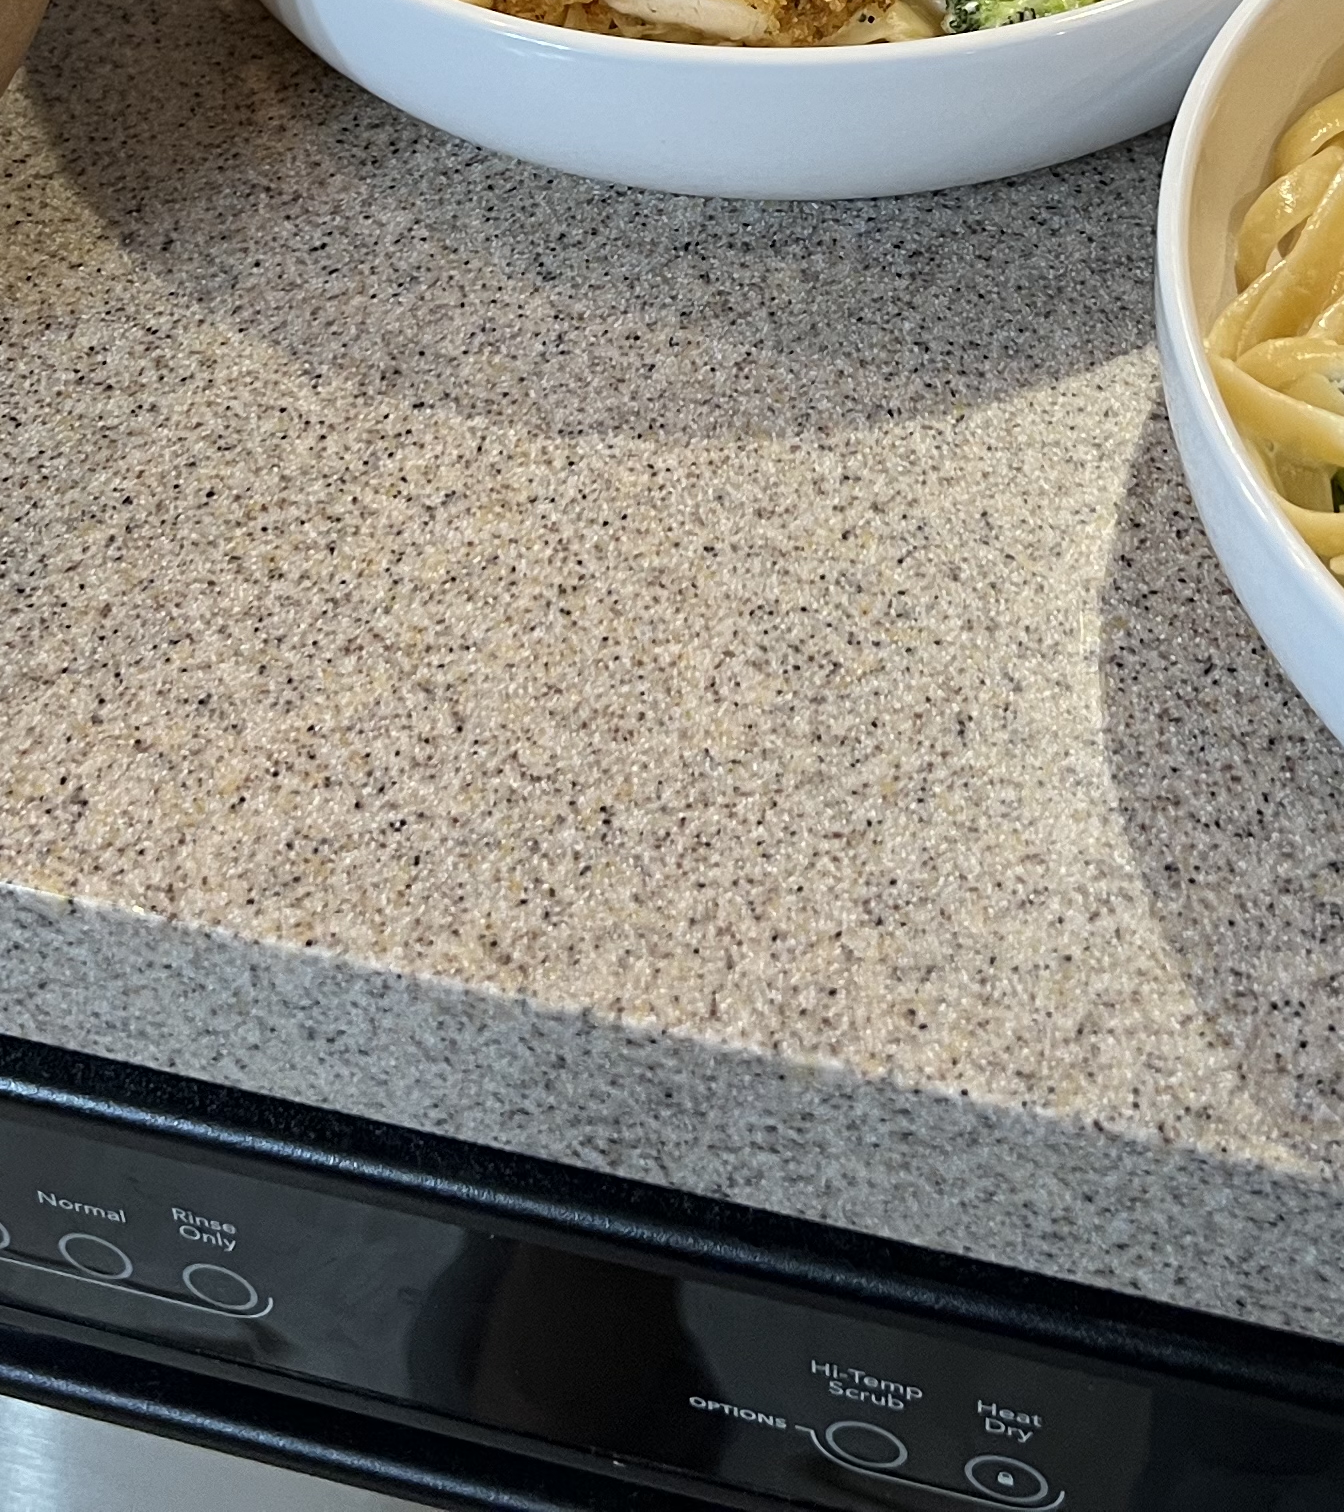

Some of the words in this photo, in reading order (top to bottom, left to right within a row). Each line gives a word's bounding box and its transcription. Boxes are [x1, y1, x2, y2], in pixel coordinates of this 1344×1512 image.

[37, 1190, 127, 1224] Normal
[171, 1207, 237, 1235] Rinse
[178, 1224, 238, 1252] Only
[810, 1359, 923, 1400] Hi-Temp
[827, 1380, 905, 1410] Scrub
[688, 1396, 787, 1430] OPTIONS
[977, 1400, 1043, 1429] Heat
[984, 1416, 1034, 1443] Dry
